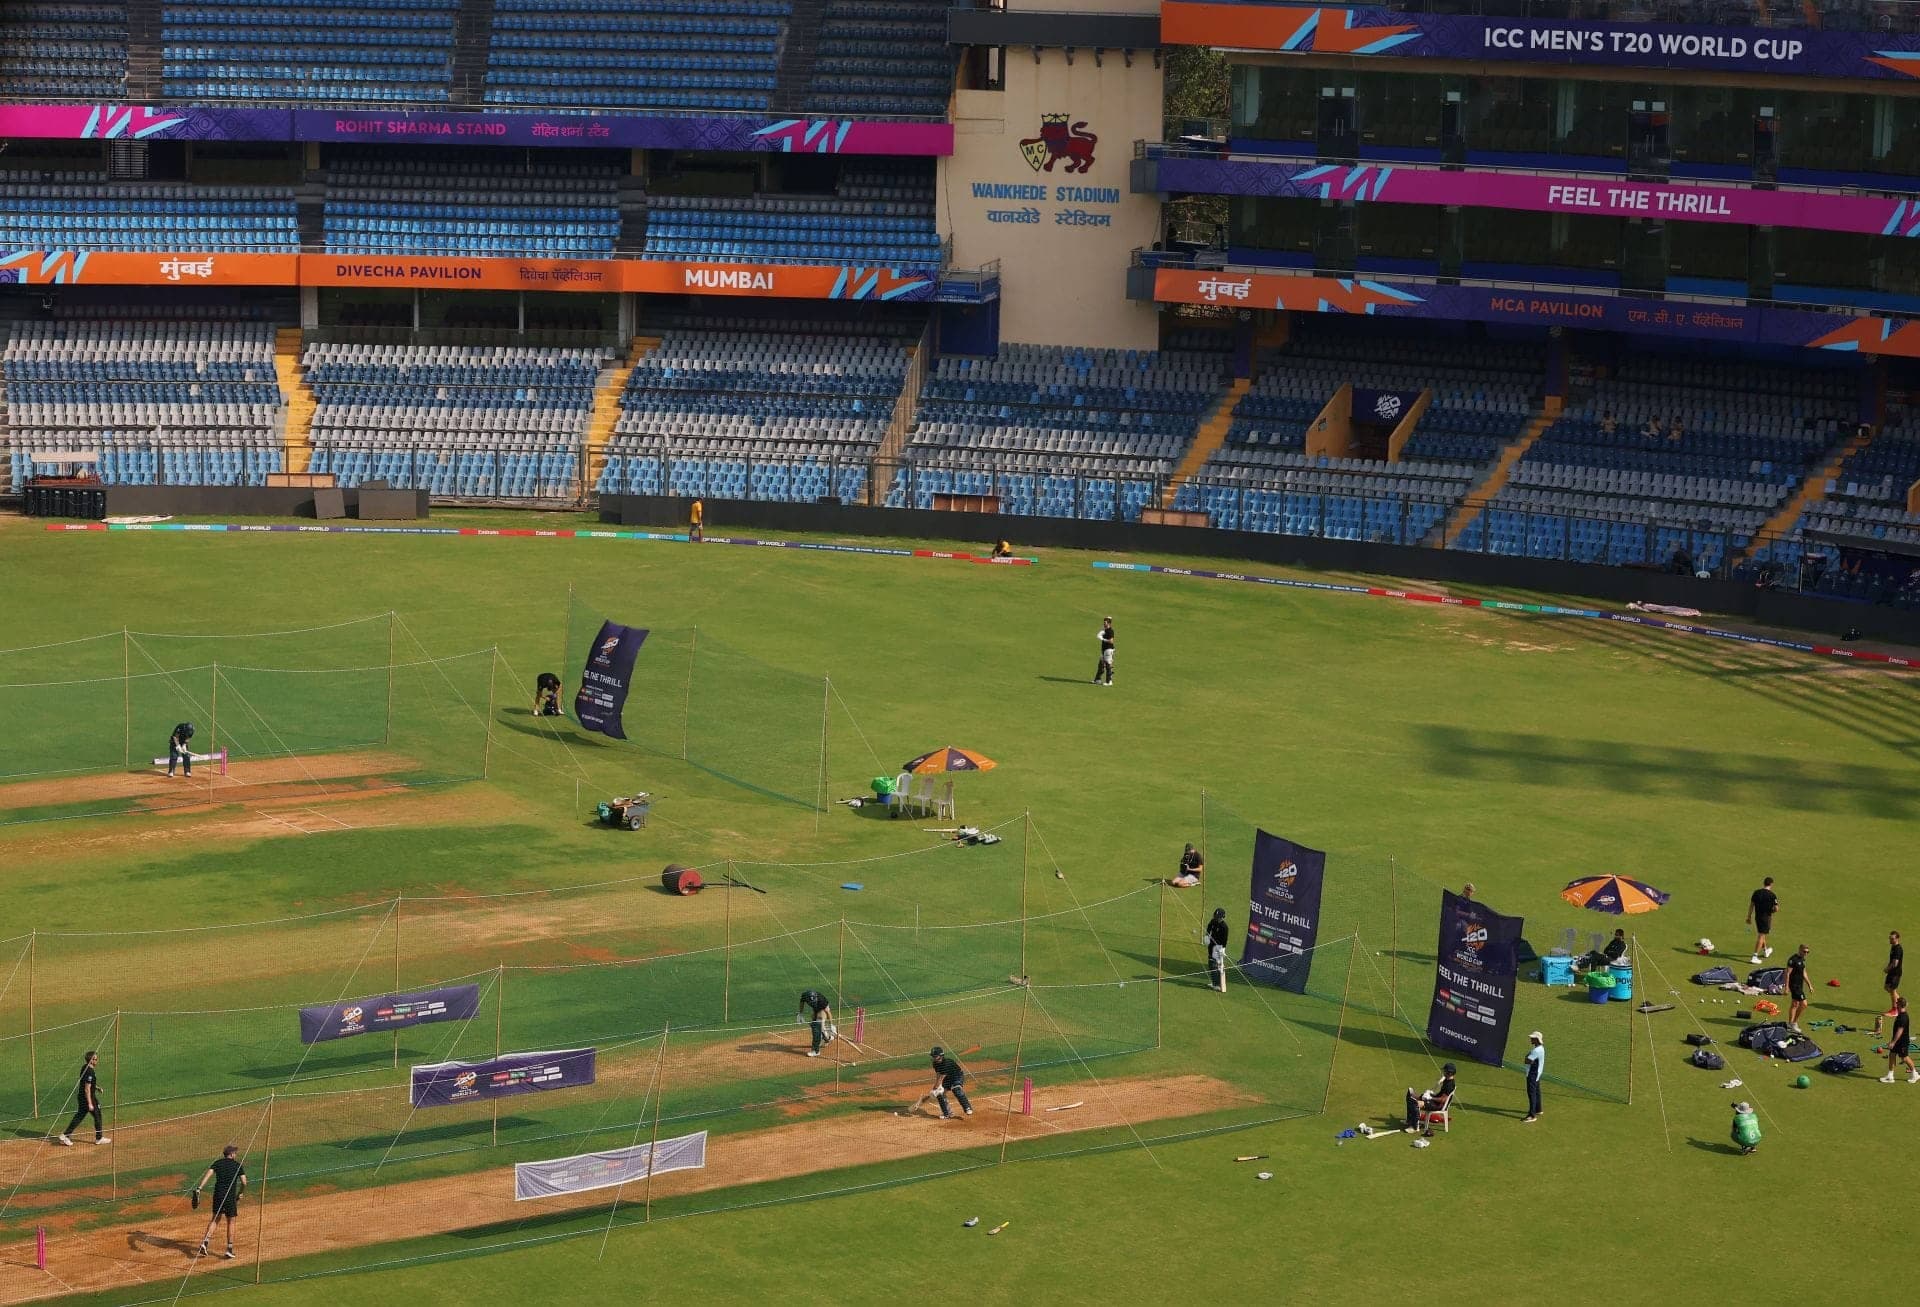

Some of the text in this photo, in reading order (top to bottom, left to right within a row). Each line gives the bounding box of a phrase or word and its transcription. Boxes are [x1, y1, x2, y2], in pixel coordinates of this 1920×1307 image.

[1484, 27, 1804, 61] ICC MEN'S T20 WORLD CUP
[336, 120, 507, 136] ROHIT SHARMA STAND
[531, 122, 559, 138] रोहित
[971, 182, 1120, 204] WANKHEDE STADIUM
[1548, 185, 1731, 216] FEEL THE THRILL
[986, 207, 1112, 227] वानखेडे स्टेडियम
[159, 256, 214, 281] मुंबई
[336, 265, 482, 279] DIVECHA PAVILION
[685, 269, 773, 290] MUMBAI
[1197, 276, 1252, 301] मुंबई
[1490, 297, 1604, 319] MCA PAVILION
[600, 674, 623, 688] THRILL
[1264, 906, 1281, 921] THE
[1281, 912, 1311, 929] THRILL
[1438, 963, 1453, 981] FEEL
[1453, 972, 1470, 987] THE
[1470, 978, 1505, 999] THRILL
